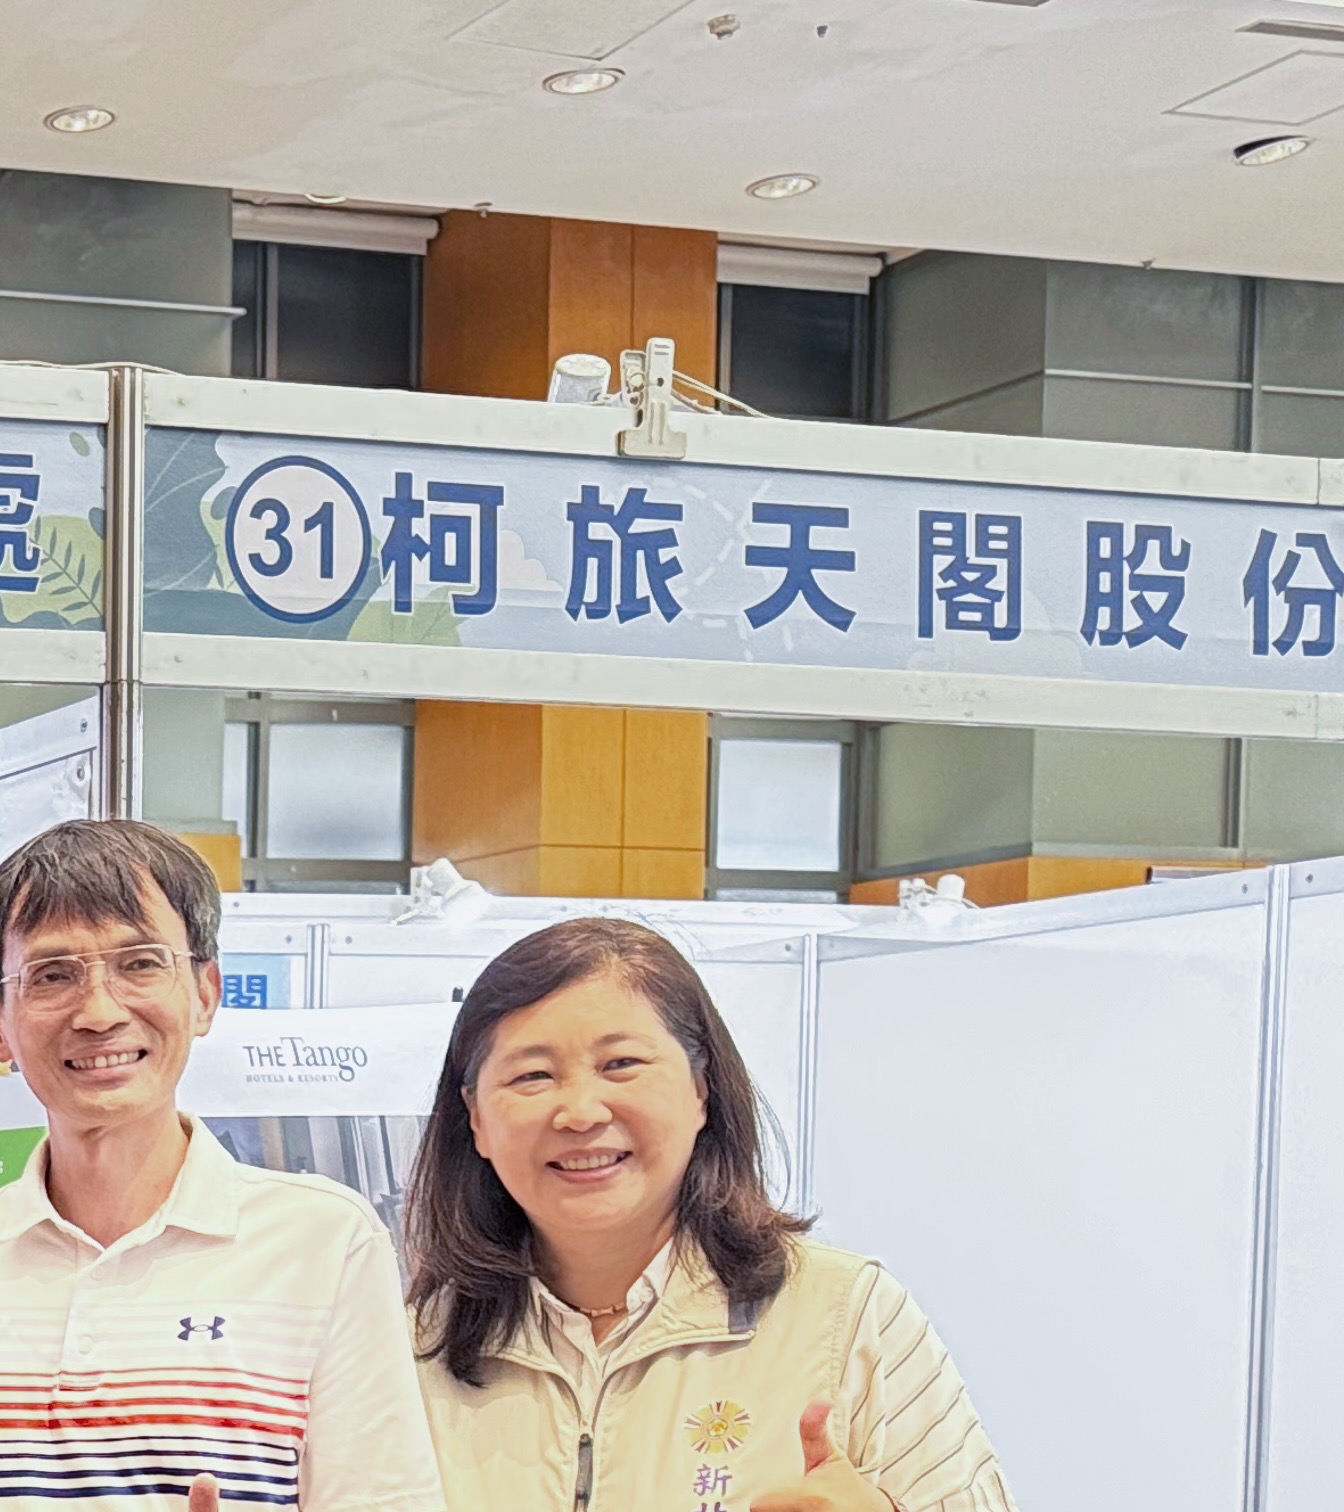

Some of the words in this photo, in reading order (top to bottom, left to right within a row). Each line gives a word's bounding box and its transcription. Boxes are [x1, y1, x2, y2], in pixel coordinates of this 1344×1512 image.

[246, 496, 337, 580] 31
[380, 471, 1344, 658] 柯旅天閣股份
[242, 1045, 287, 1067] THE
[280, 1036, 368, 1083] Tango
